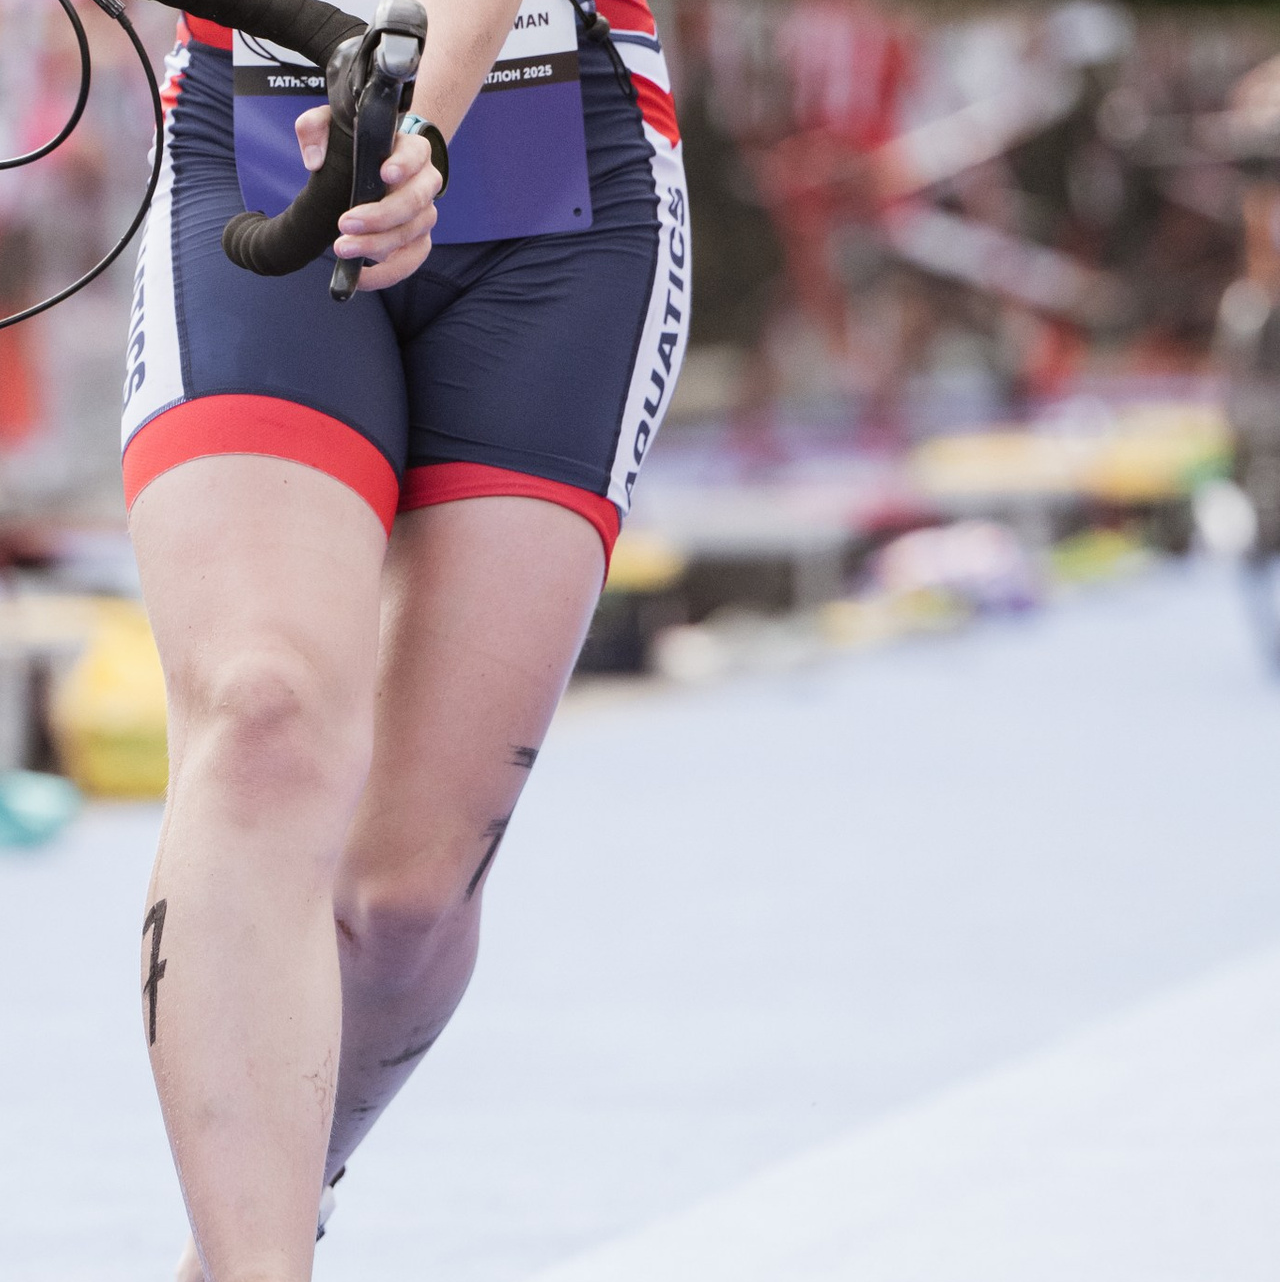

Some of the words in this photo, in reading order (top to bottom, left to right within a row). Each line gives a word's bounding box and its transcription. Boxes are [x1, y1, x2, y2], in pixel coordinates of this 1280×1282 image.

[483, 69, 521, 85] ТЛОН
[523, 64, 553, 80] 2025
[624, 186, 686, 508] AQUATICS
[142, 897, 168, 1047] 7
